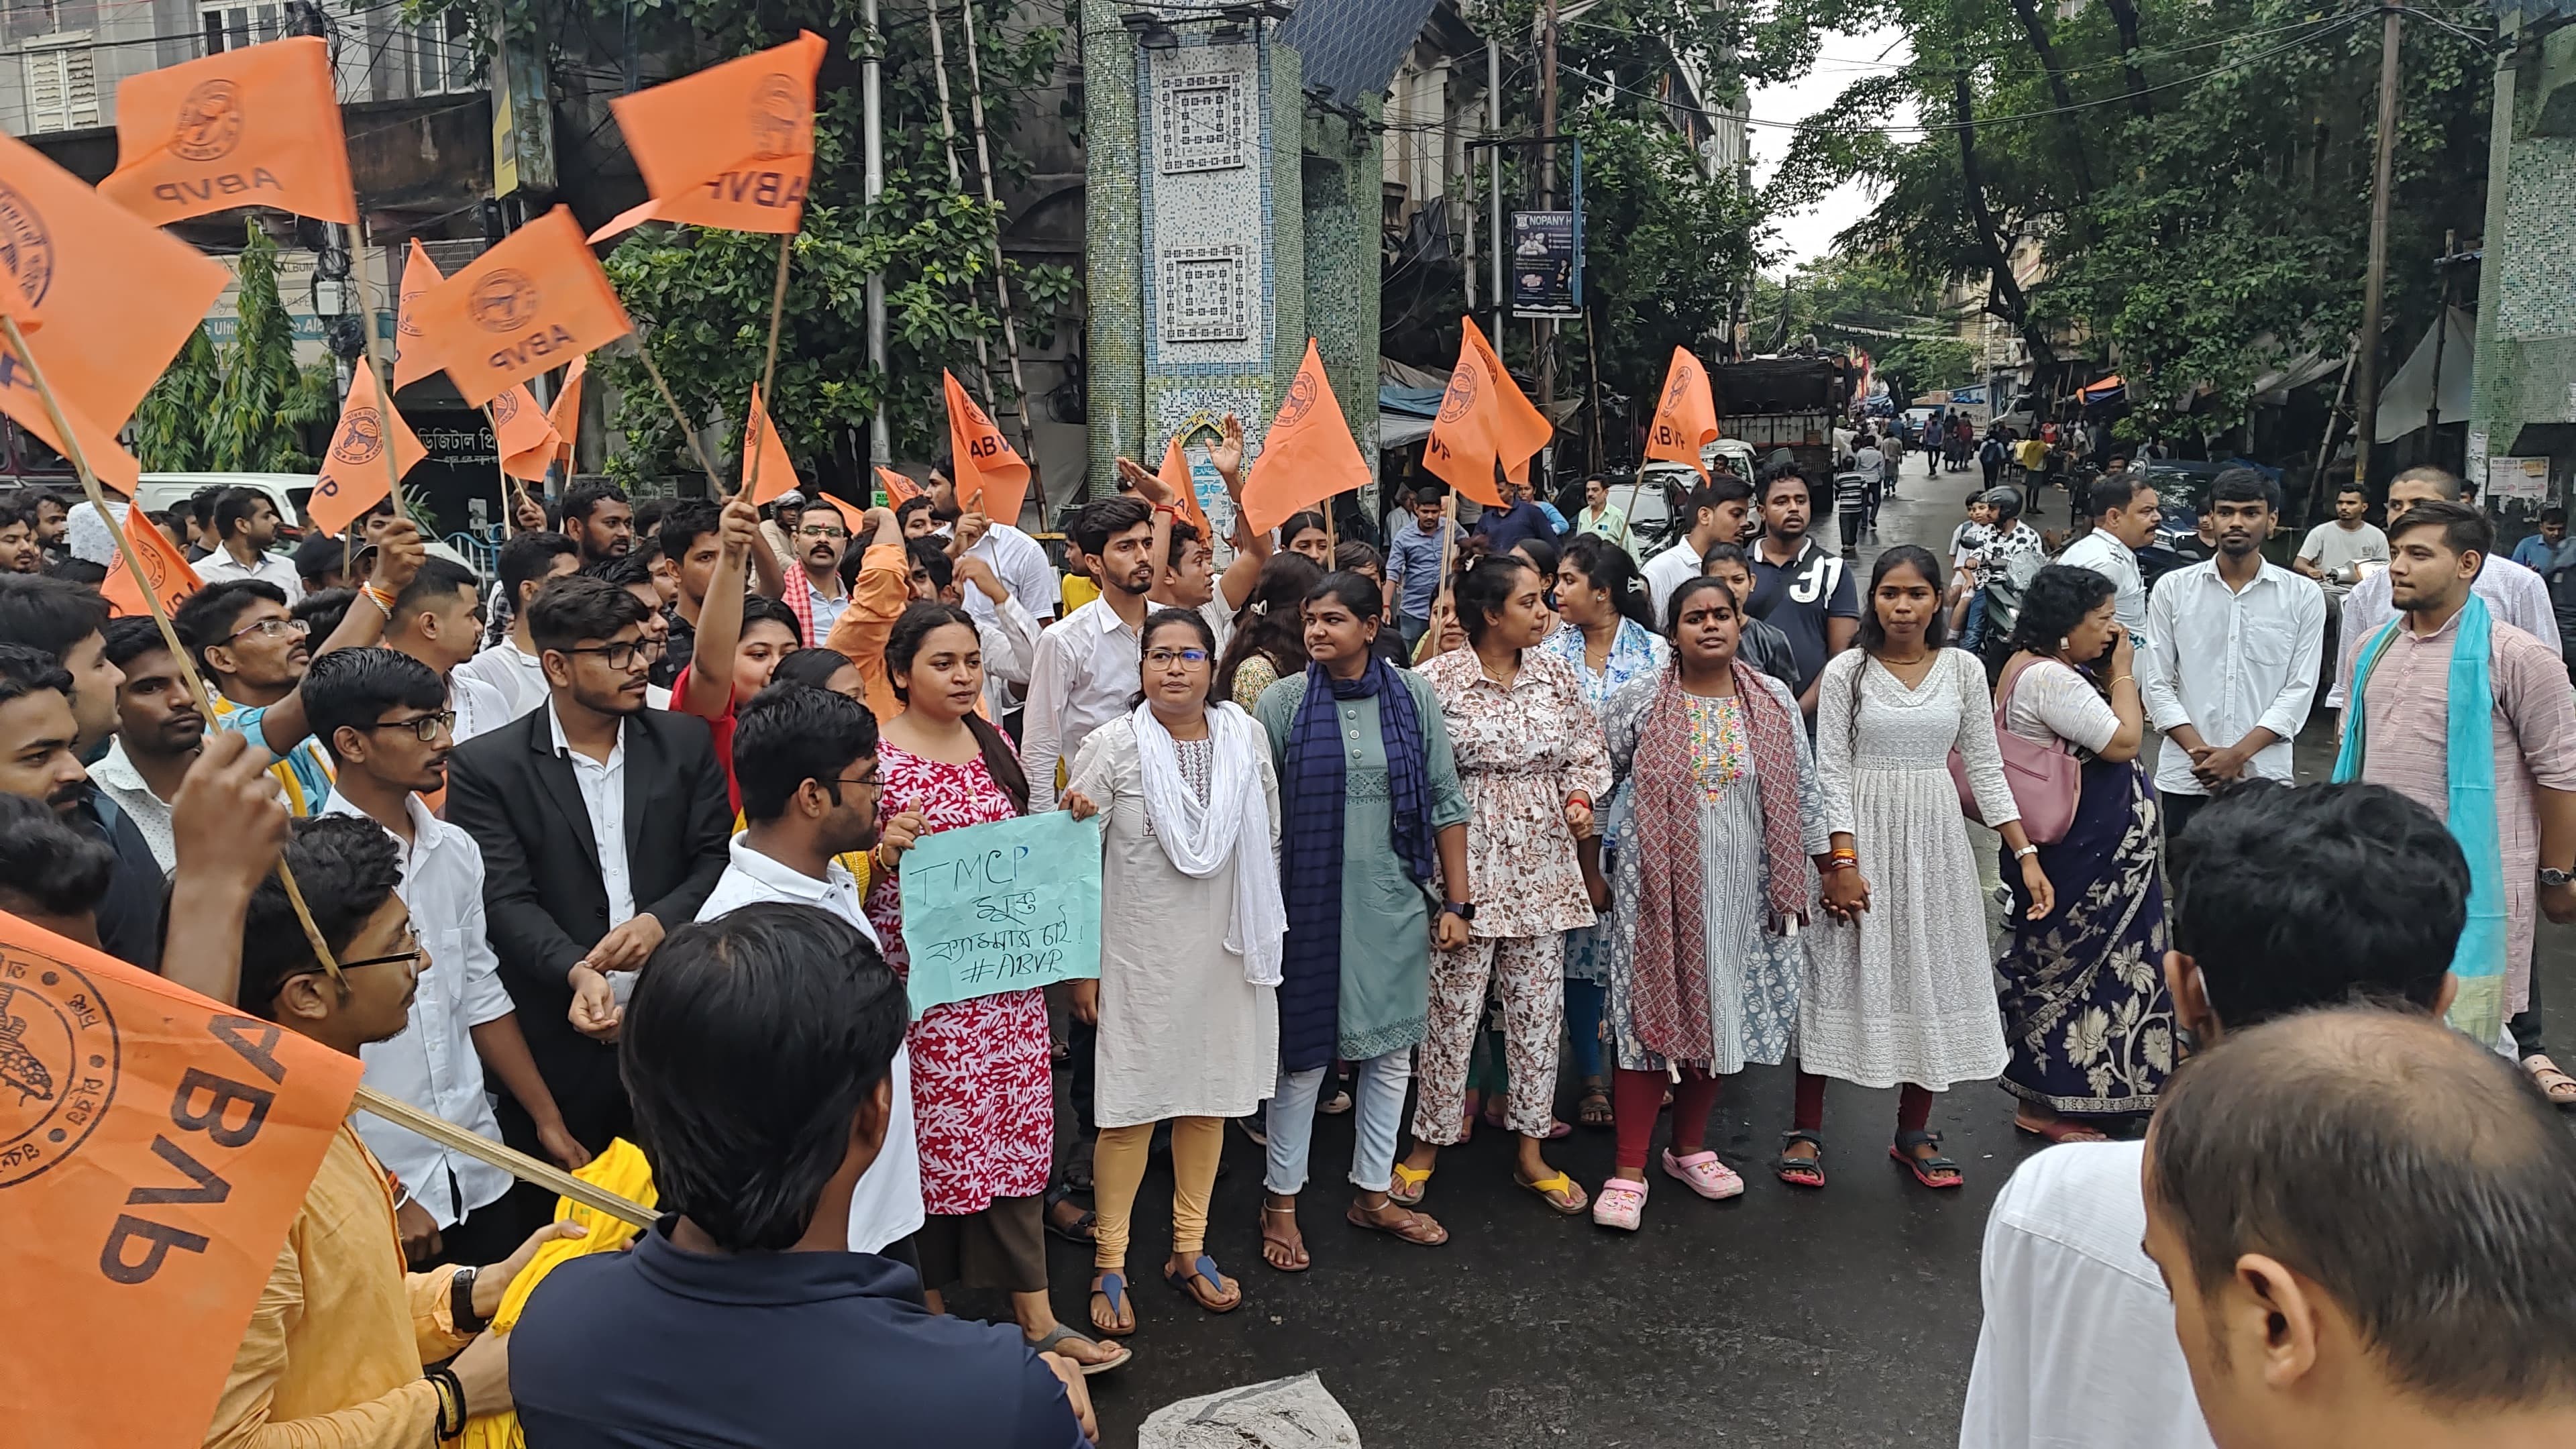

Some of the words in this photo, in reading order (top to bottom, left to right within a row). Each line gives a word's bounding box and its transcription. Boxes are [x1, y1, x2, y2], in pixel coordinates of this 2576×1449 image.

[1529, 215, 1564, 226] NOPANY
[1566, 215, 1586, 226] HH
[281, 262, 314, 273] ALBUM
[286, 297, 312, 307] PAPE
[303, 319, 324, 332] Alb
[417, 427, 475, 451] ডিজিটাল
[970, 435, 1010, 460] ABV
[909, 845, 1030, 906] TMCP
[961, 949, 1063, 984] #ABVP
